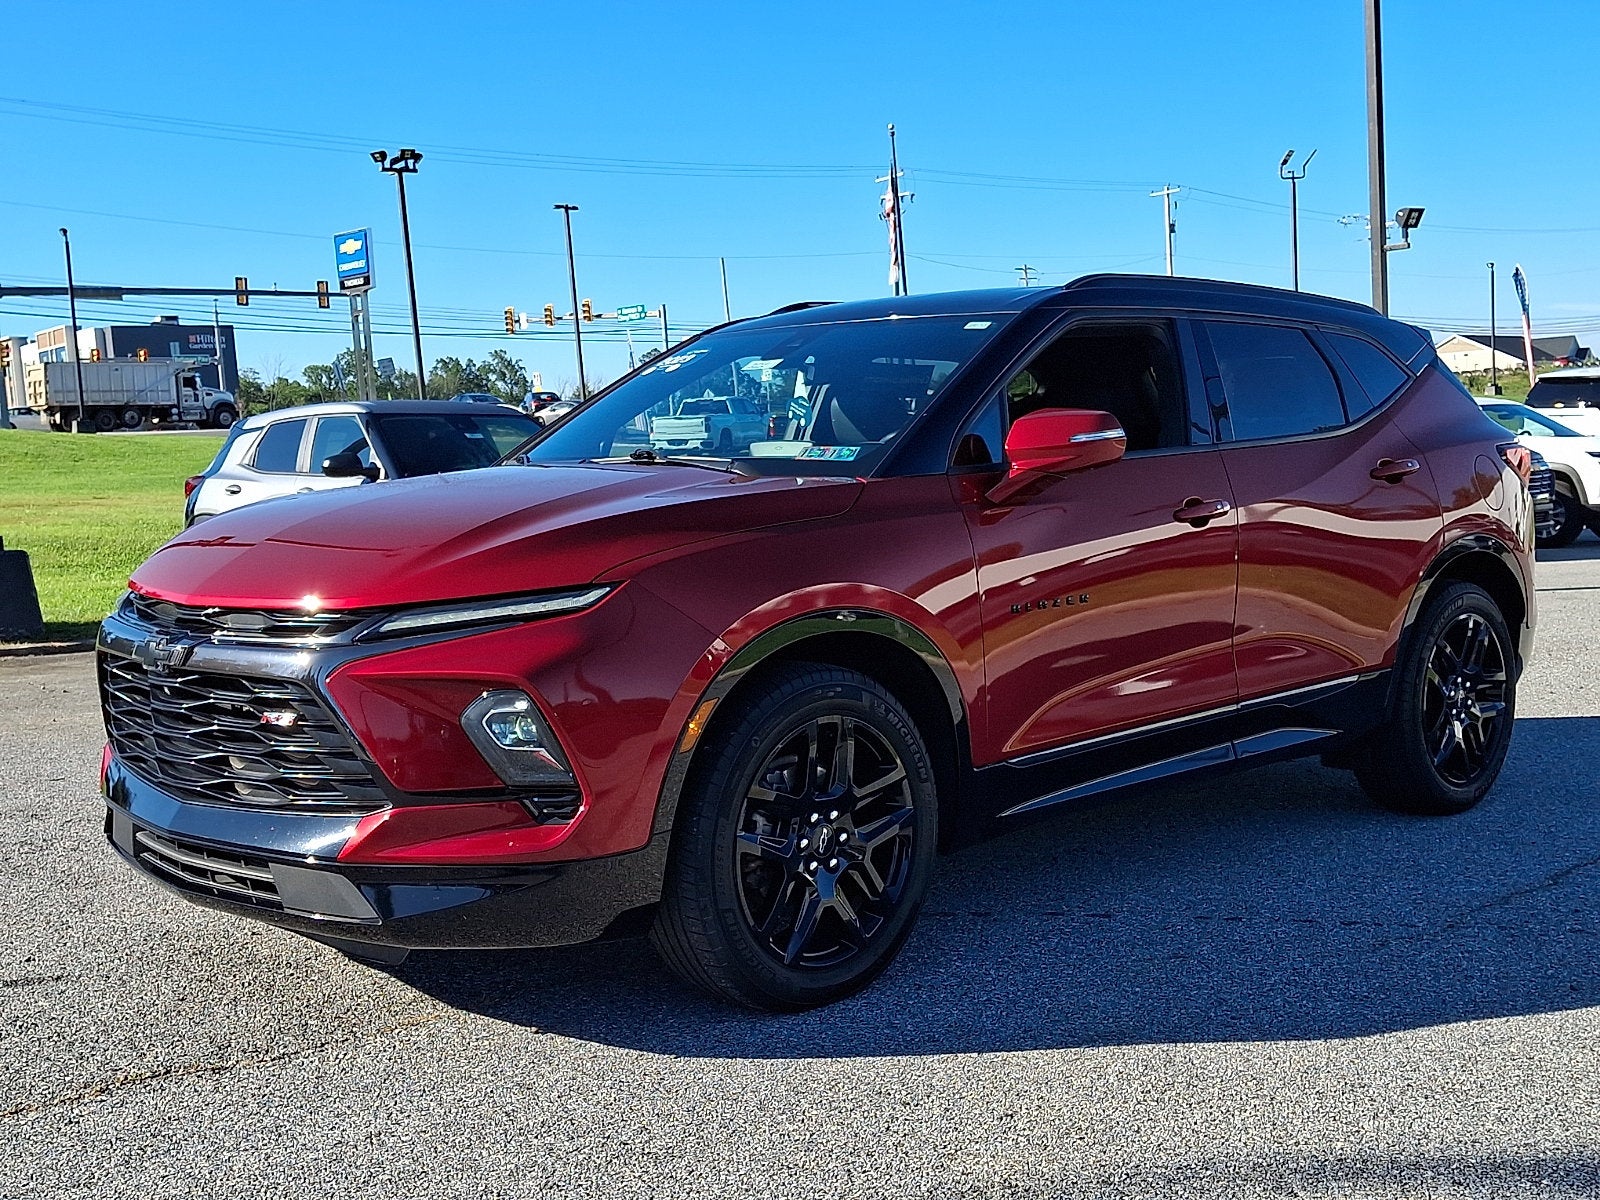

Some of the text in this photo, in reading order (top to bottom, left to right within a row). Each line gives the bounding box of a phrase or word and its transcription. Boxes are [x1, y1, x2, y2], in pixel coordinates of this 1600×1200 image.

[196, 334, 226, 343] Hiltn
[1010, 593, 1090, 614] BLAZER
[887, 712, 929, 783] MICHELIN
